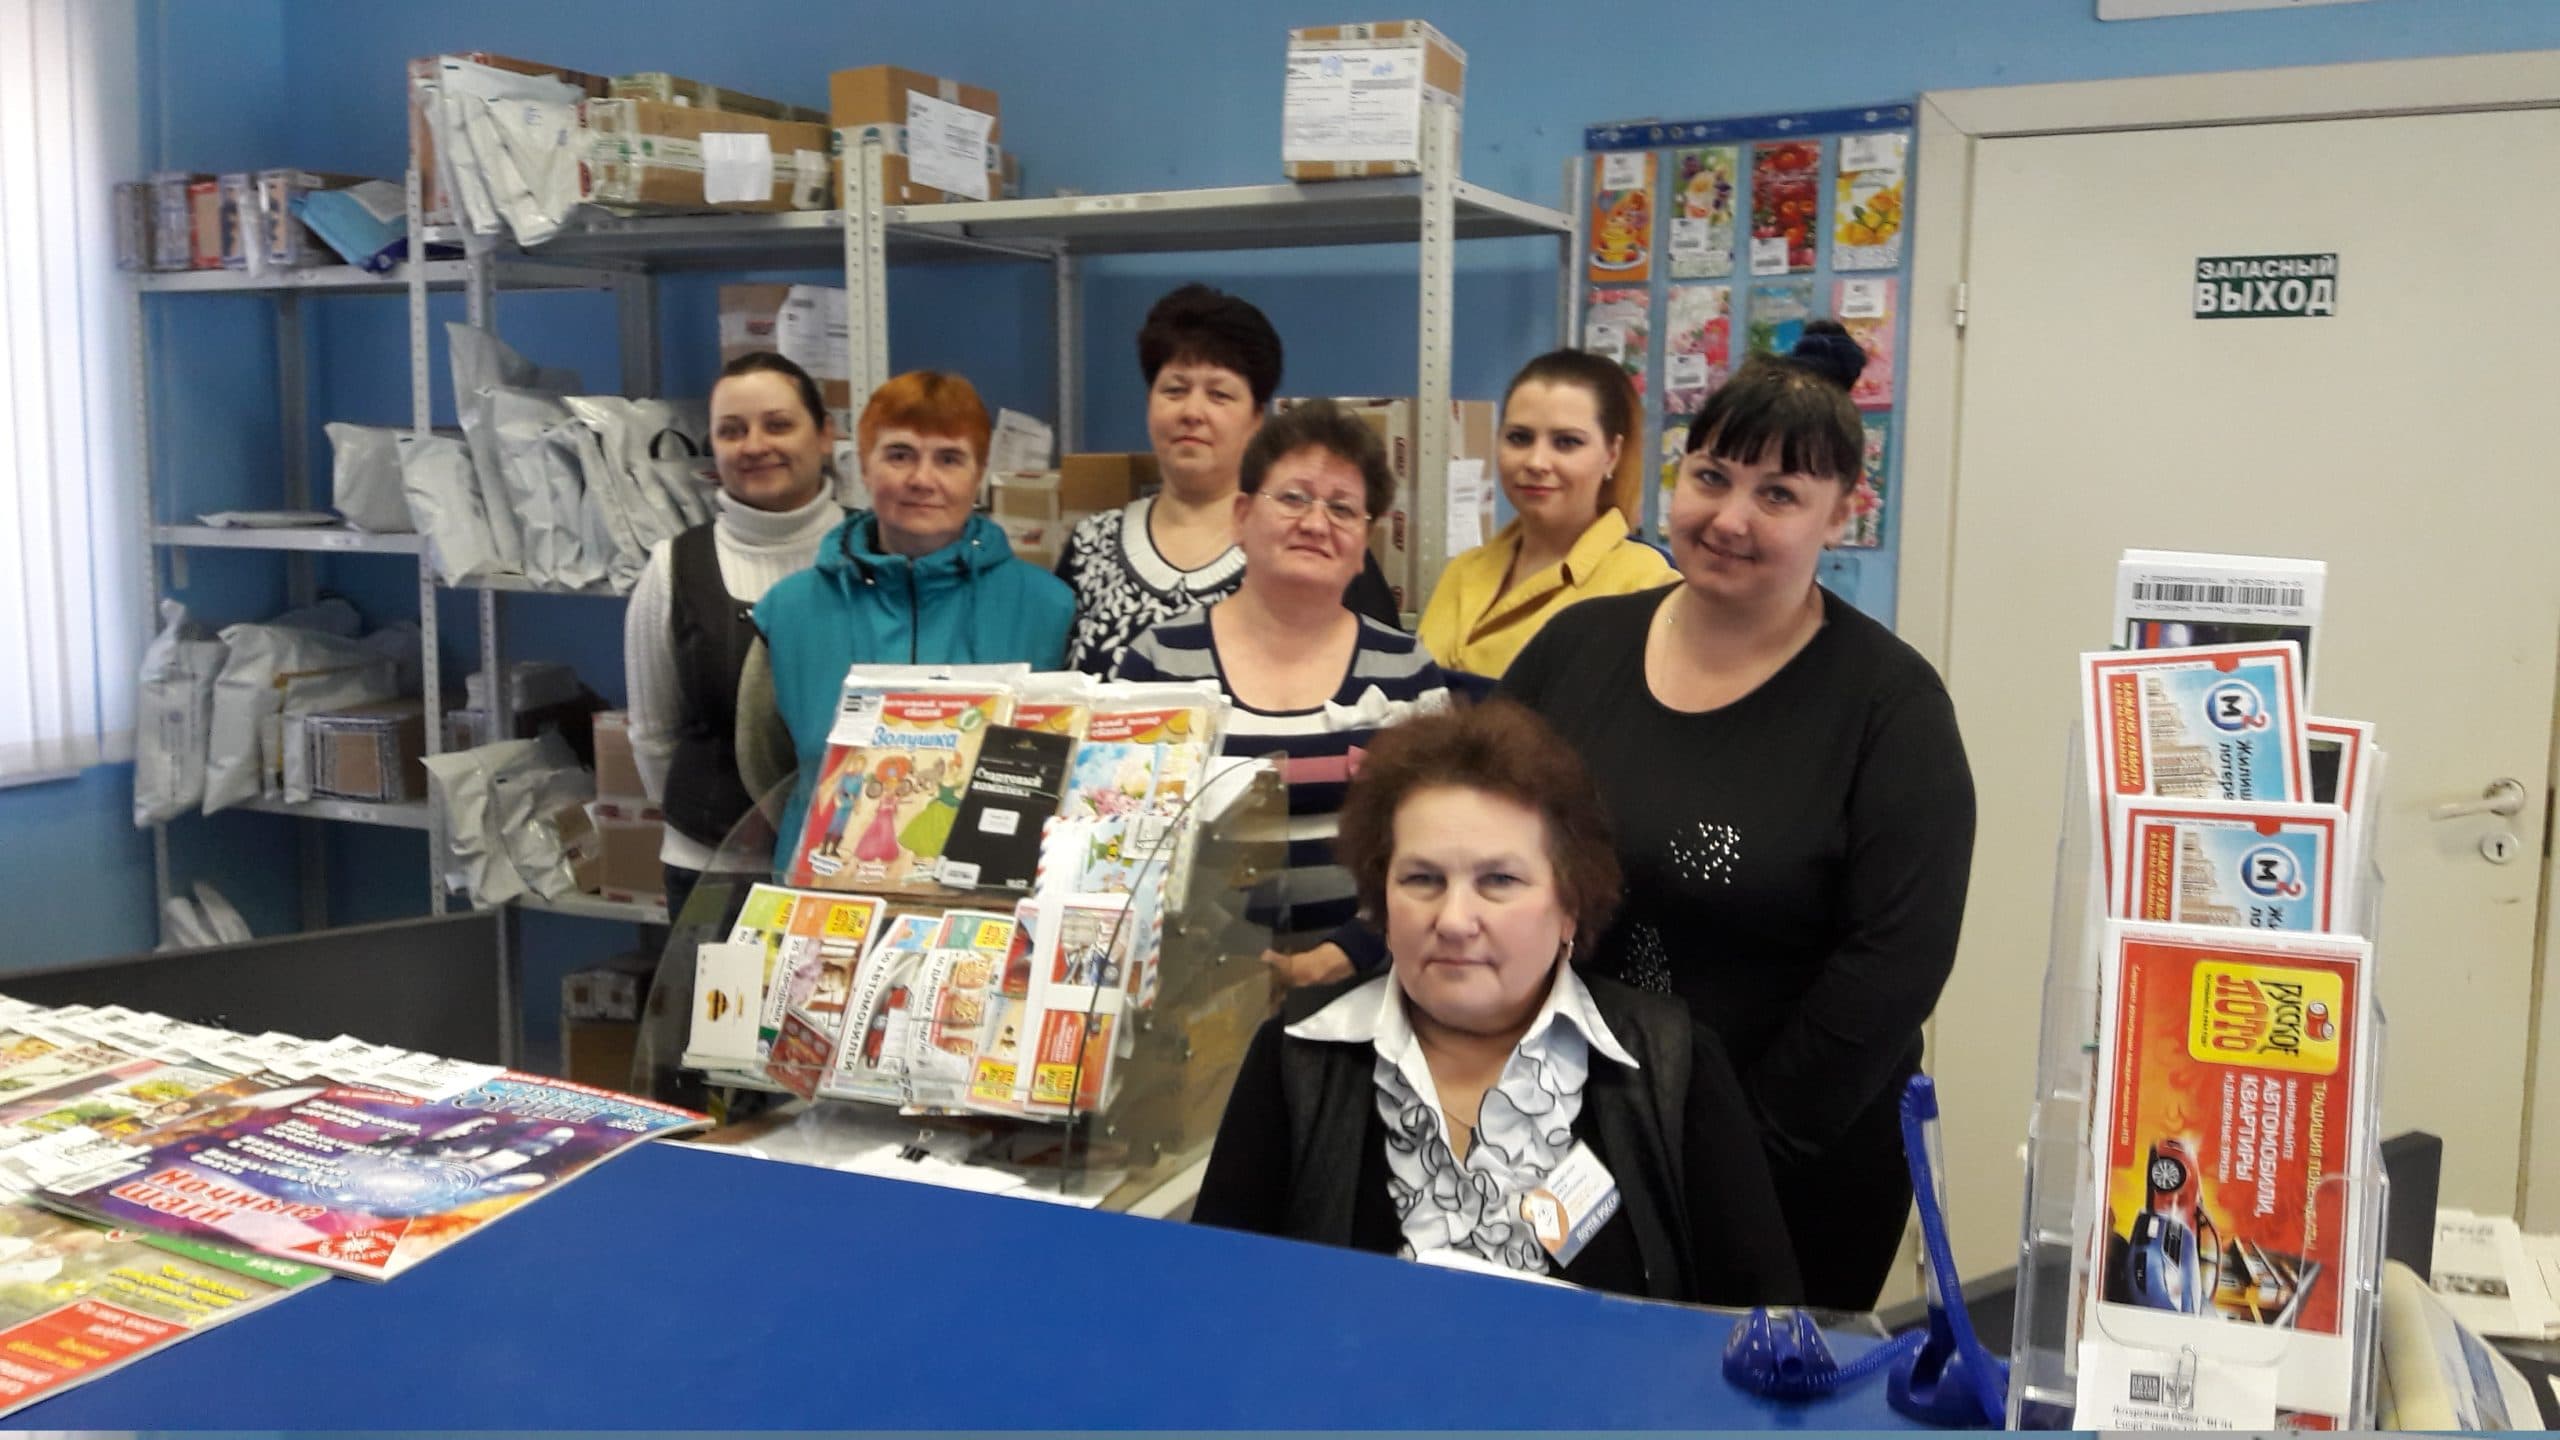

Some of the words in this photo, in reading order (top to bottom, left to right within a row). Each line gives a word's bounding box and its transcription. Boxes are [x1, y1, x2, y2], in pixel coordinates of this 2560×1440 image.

[2196, 279, 2335, 316] ВЫХОД
[2199, 255, 2336, 279] ЗАПАСНЫЙ
[872, 726, 957, 751] Золушка
[2213, 973, 2268, 1051] ЛОТО
[2259, 979, 2303, 1057] РУССКОЕ
[2221, 1083, 2235, 1144] ДЕНЕЖНЫЕ
[2236, 1074, 2259, 1182] КВАРТИРЫ
[2254, 1076, 2282, 1218] АВТОМОБИЛИ,
[2283, 1079, 2297, 1160] ВЫИГРЫВАЙТЕ
[2309, 1081, 2327, 1157] ТРАДИЦИЯ
[2219, 1147, 2232, 1184] ПРИЗЫ
